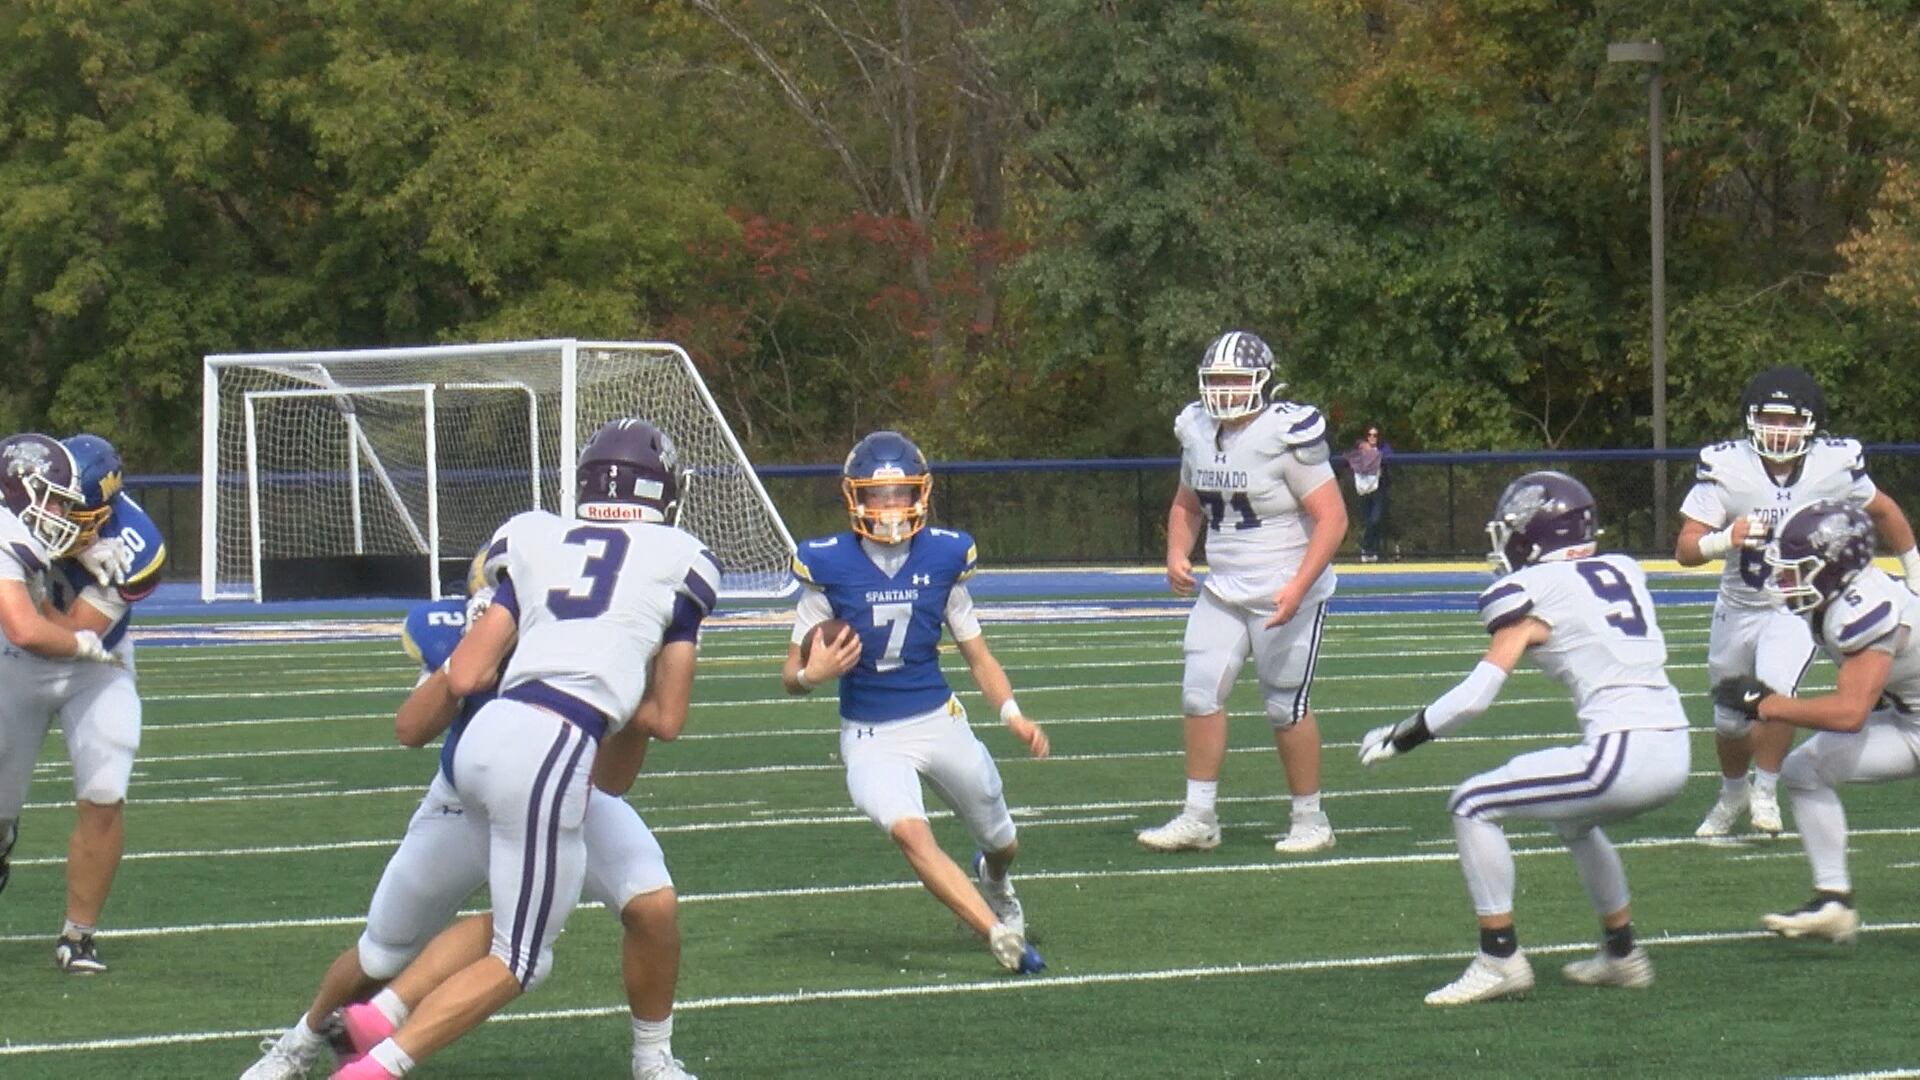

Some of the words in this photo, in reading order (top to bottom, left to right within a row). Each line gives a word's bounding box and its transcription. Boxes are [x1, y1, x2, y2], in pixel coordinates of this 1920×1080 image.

[609, 465, 618, 477] 3
[1196, 470, 1248, 488] TORNADO
[588, 507, 642, 519] Riddell
[1195, 489, 1262, 531] 71
[546, 526, 631, 620] 3
[865, 589, 919, 602] SPARTANS
[1576, 561, 1648, 637] 9
[872, 603, 912, 672] 7
